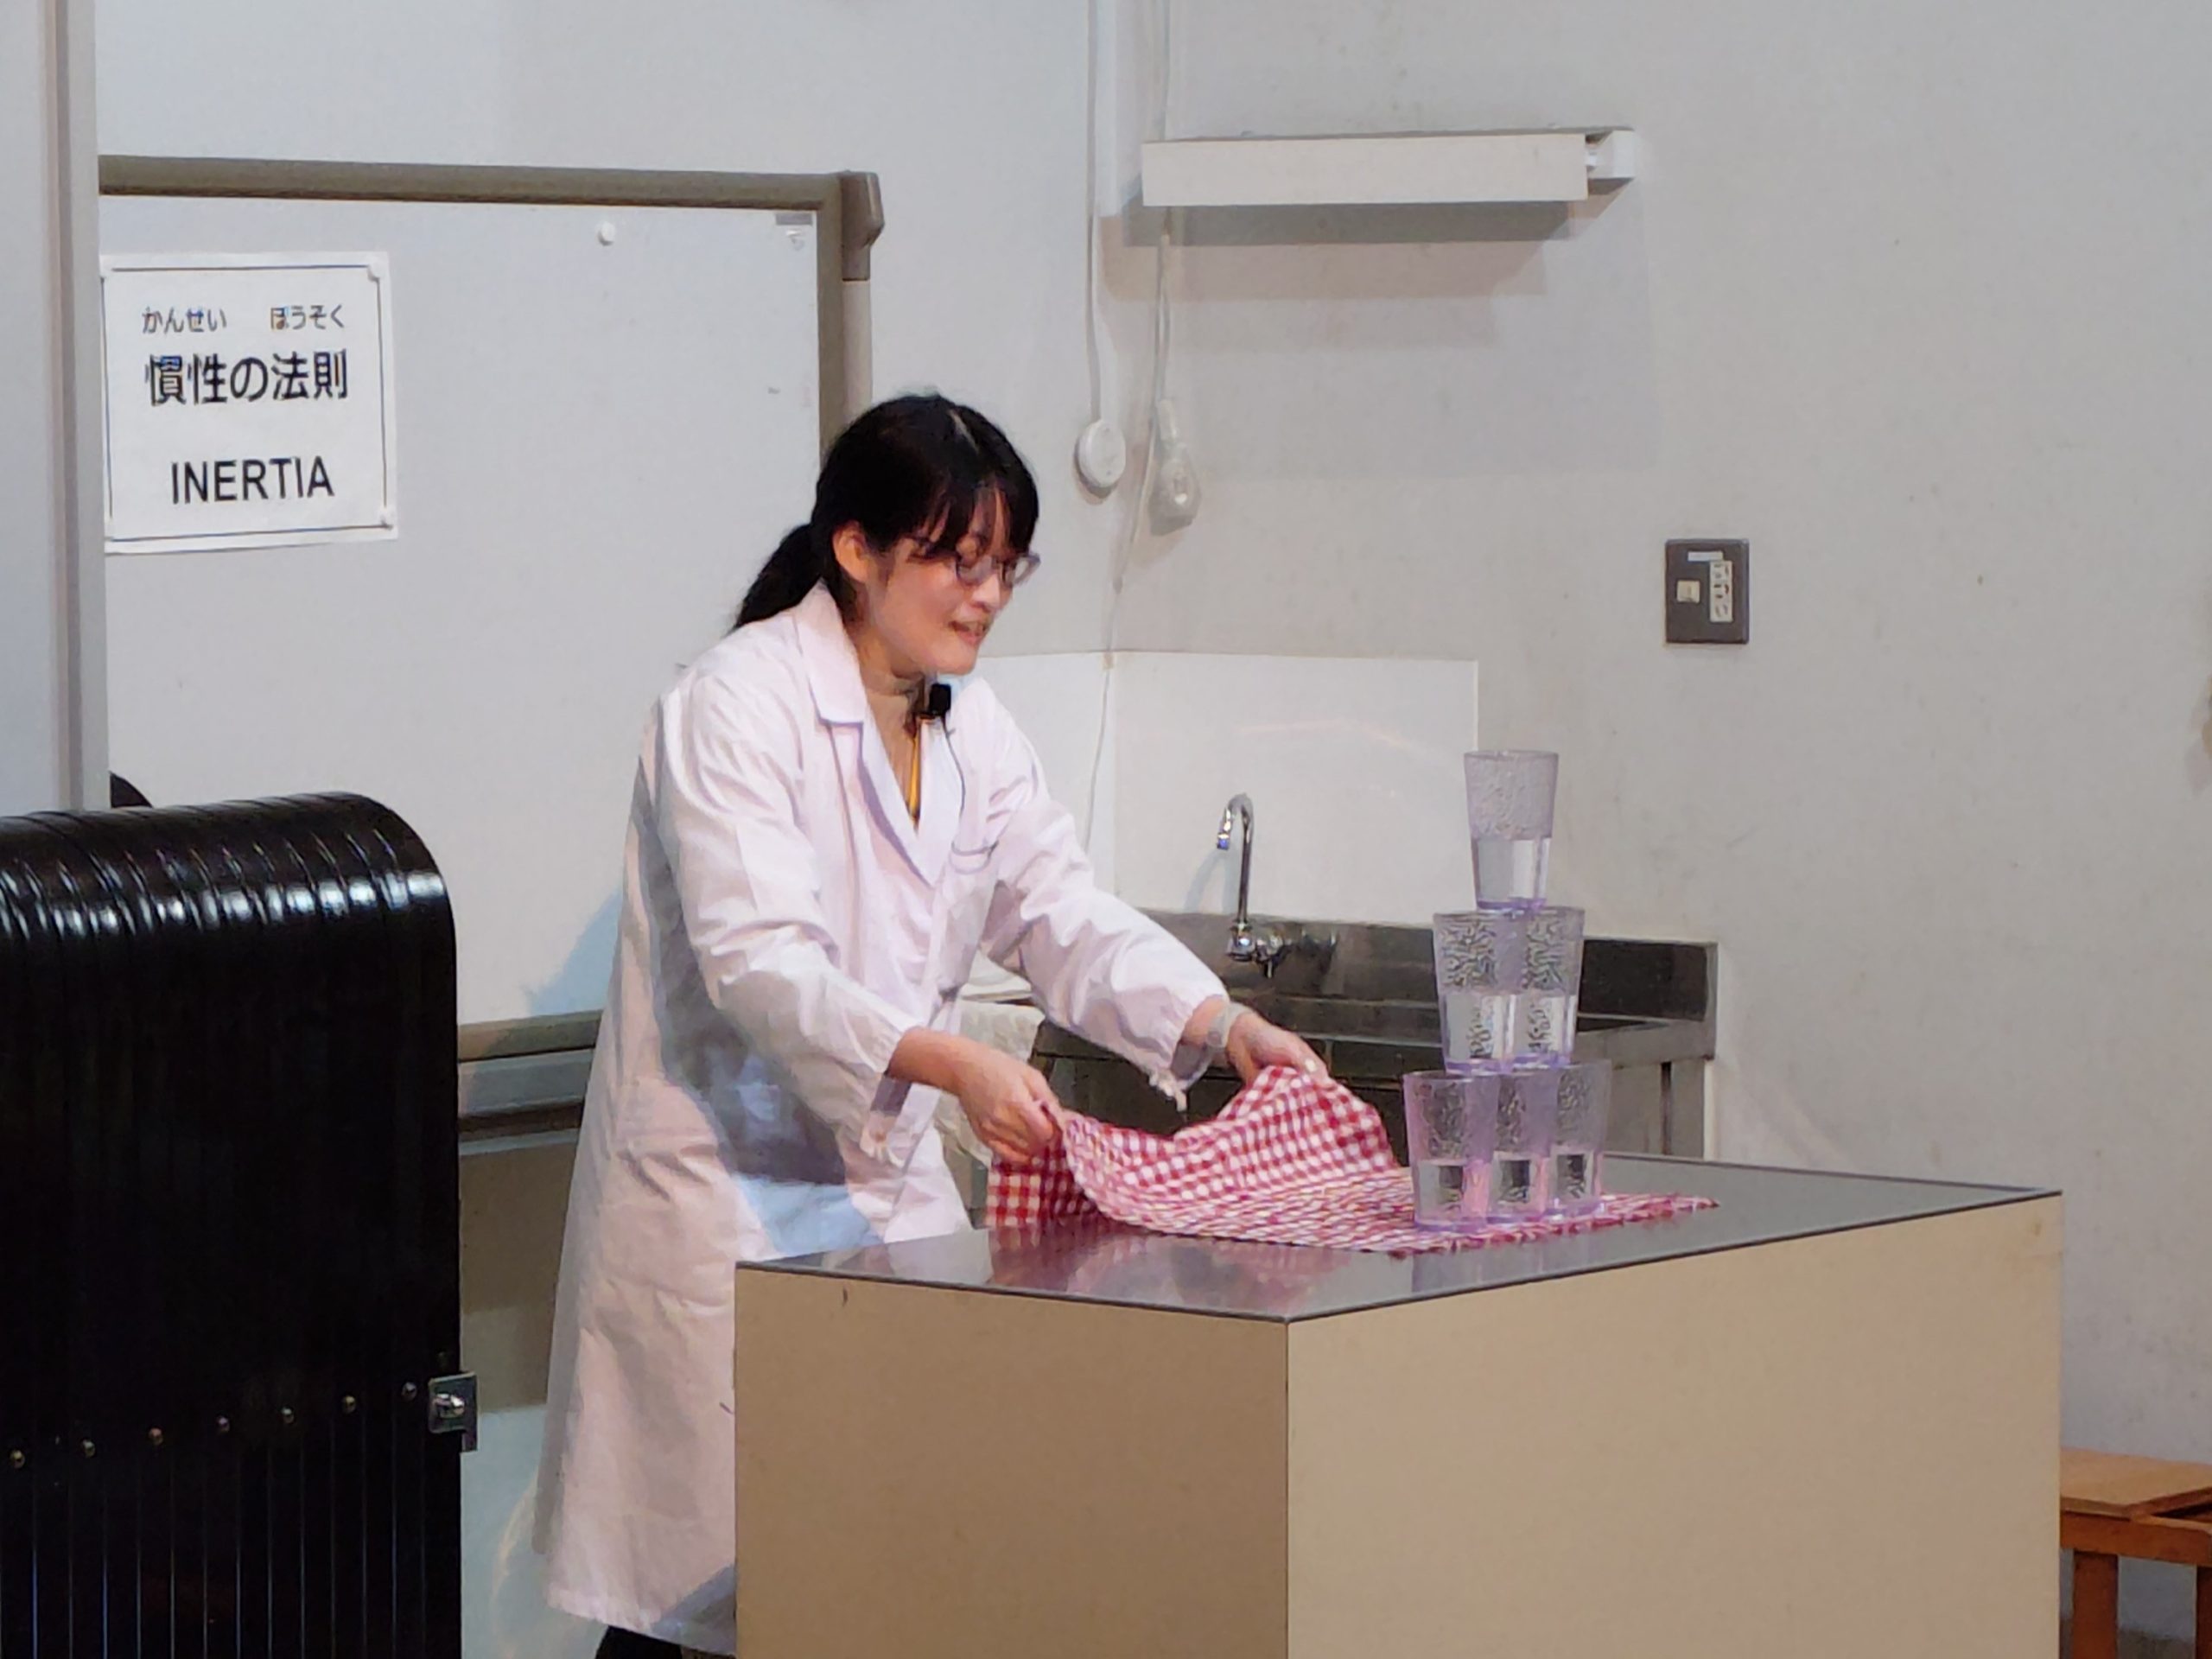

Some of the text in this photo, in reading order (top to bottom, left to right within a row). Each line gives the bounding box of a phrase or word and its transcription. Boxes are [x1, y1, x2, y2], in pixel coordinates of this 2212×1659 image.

[142, 304, 345, 334] かんせい ほうそく
[144, 348, 348, 406] 慣性の法則
[171, 455, 335, 505] INERTIA
